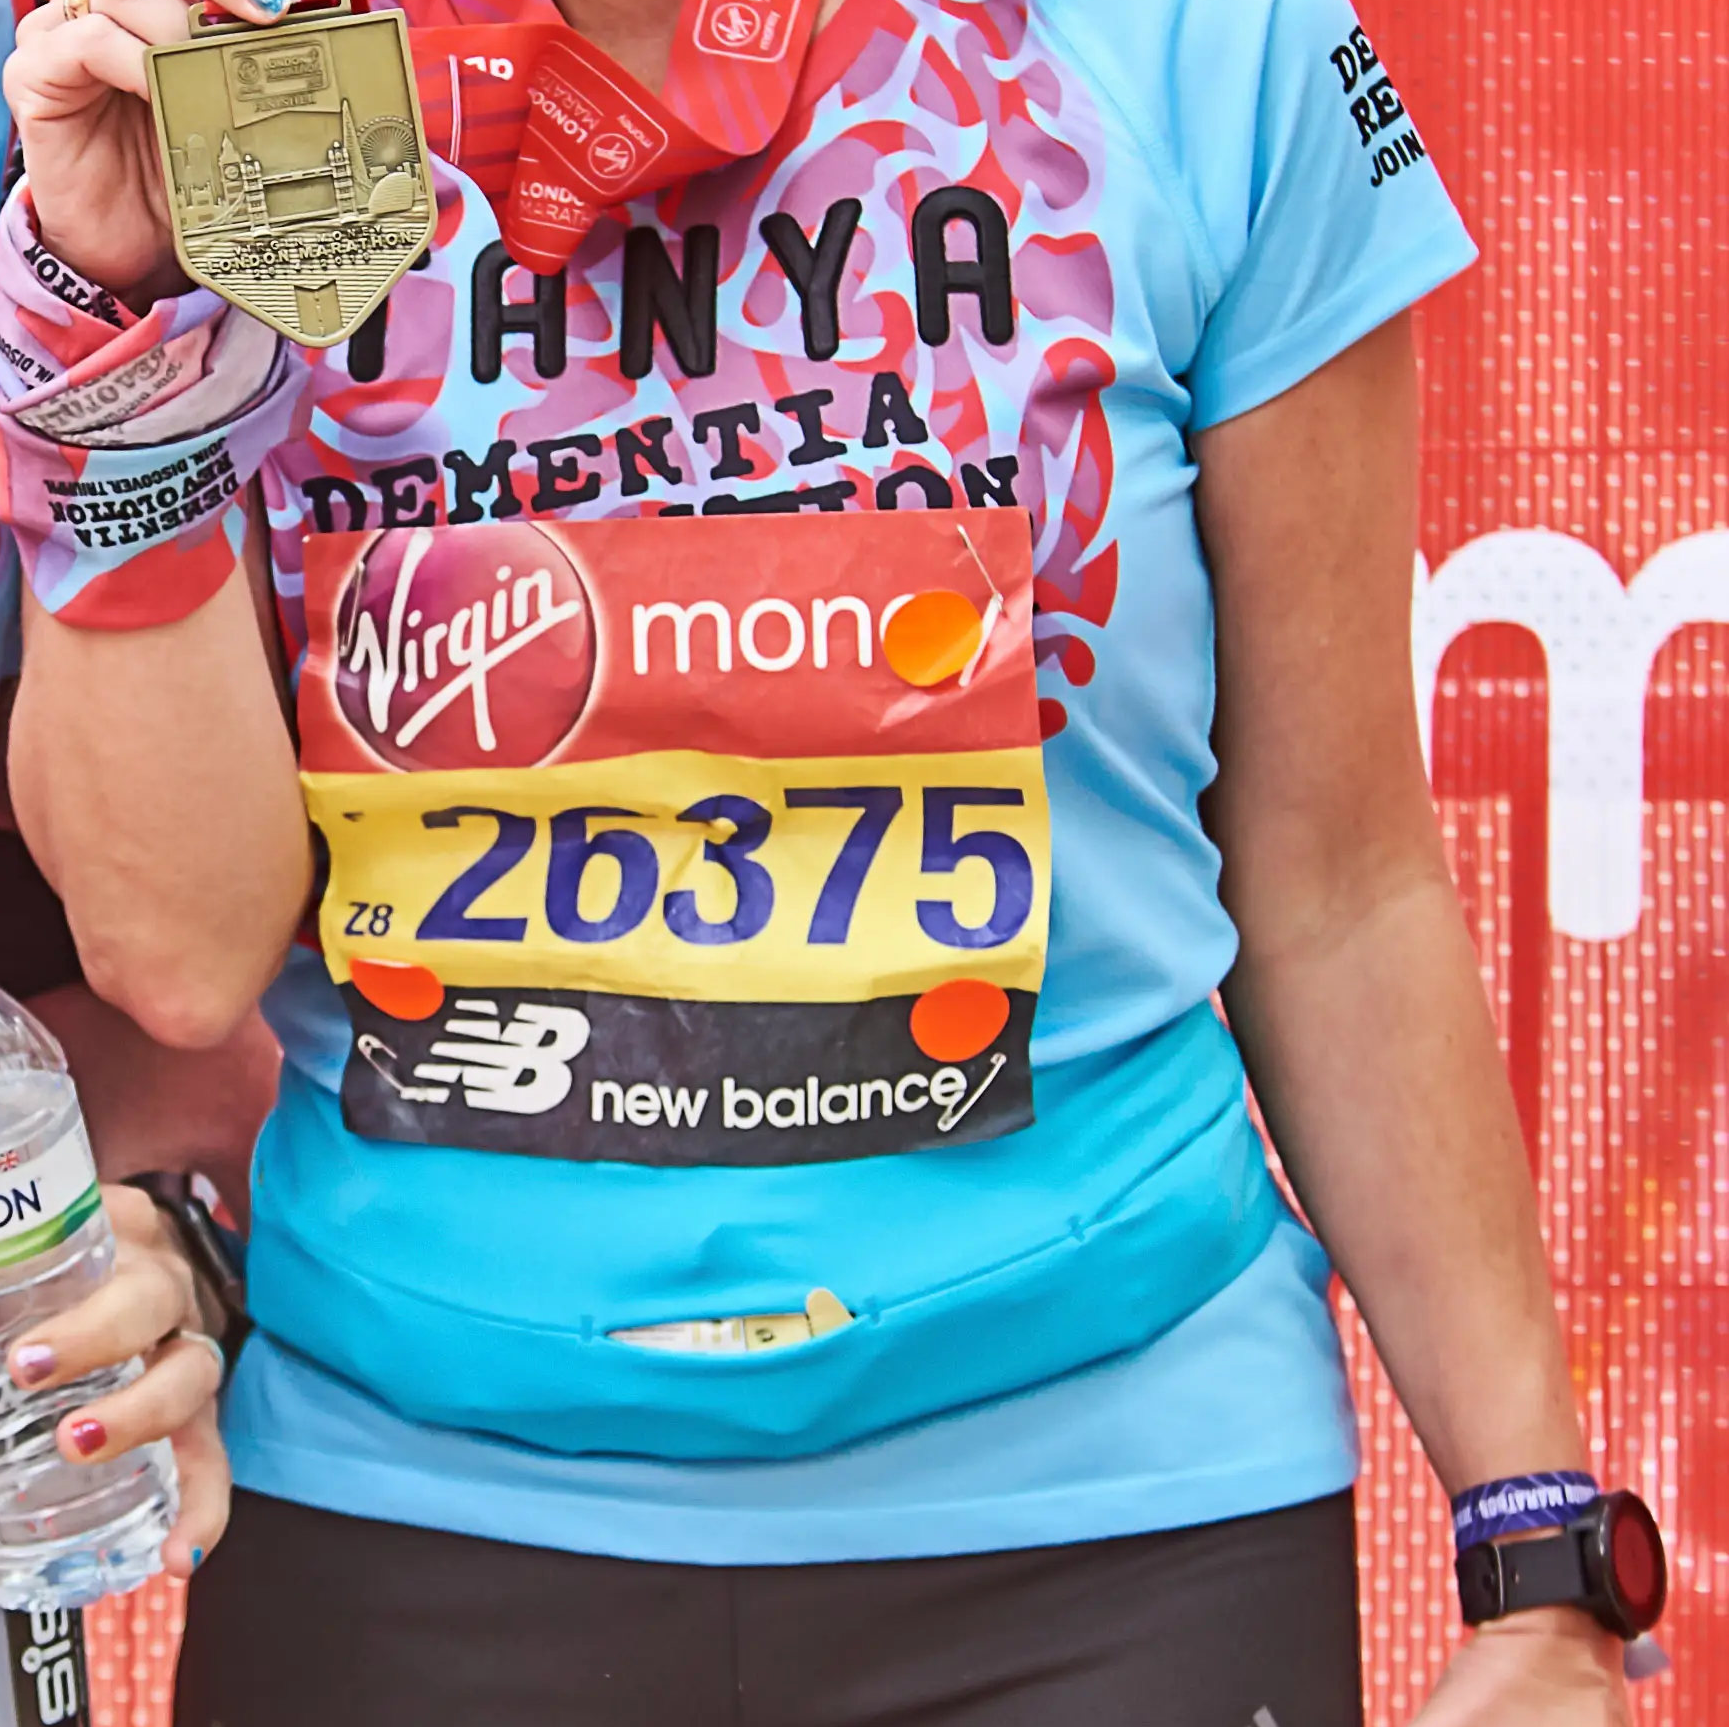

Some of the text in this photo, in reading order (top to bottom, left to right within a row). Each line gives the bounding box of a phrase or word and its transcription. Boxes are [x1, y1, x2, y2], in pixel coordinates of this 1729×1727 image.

[206, 230, 413, 274] LONDON MARATHON
[48, 450, 235, 524] REVOLUTION
[302, 371, 928, 536] DEMENTIA
[73, 471, 240, 548] DEMENTIA
[350, 528, 582, 752] Virgin
[415, 785, 1033, 950] 26375
[344, 900, 395, 938] Z8
[590, 1065, 967, 1131] new balance
